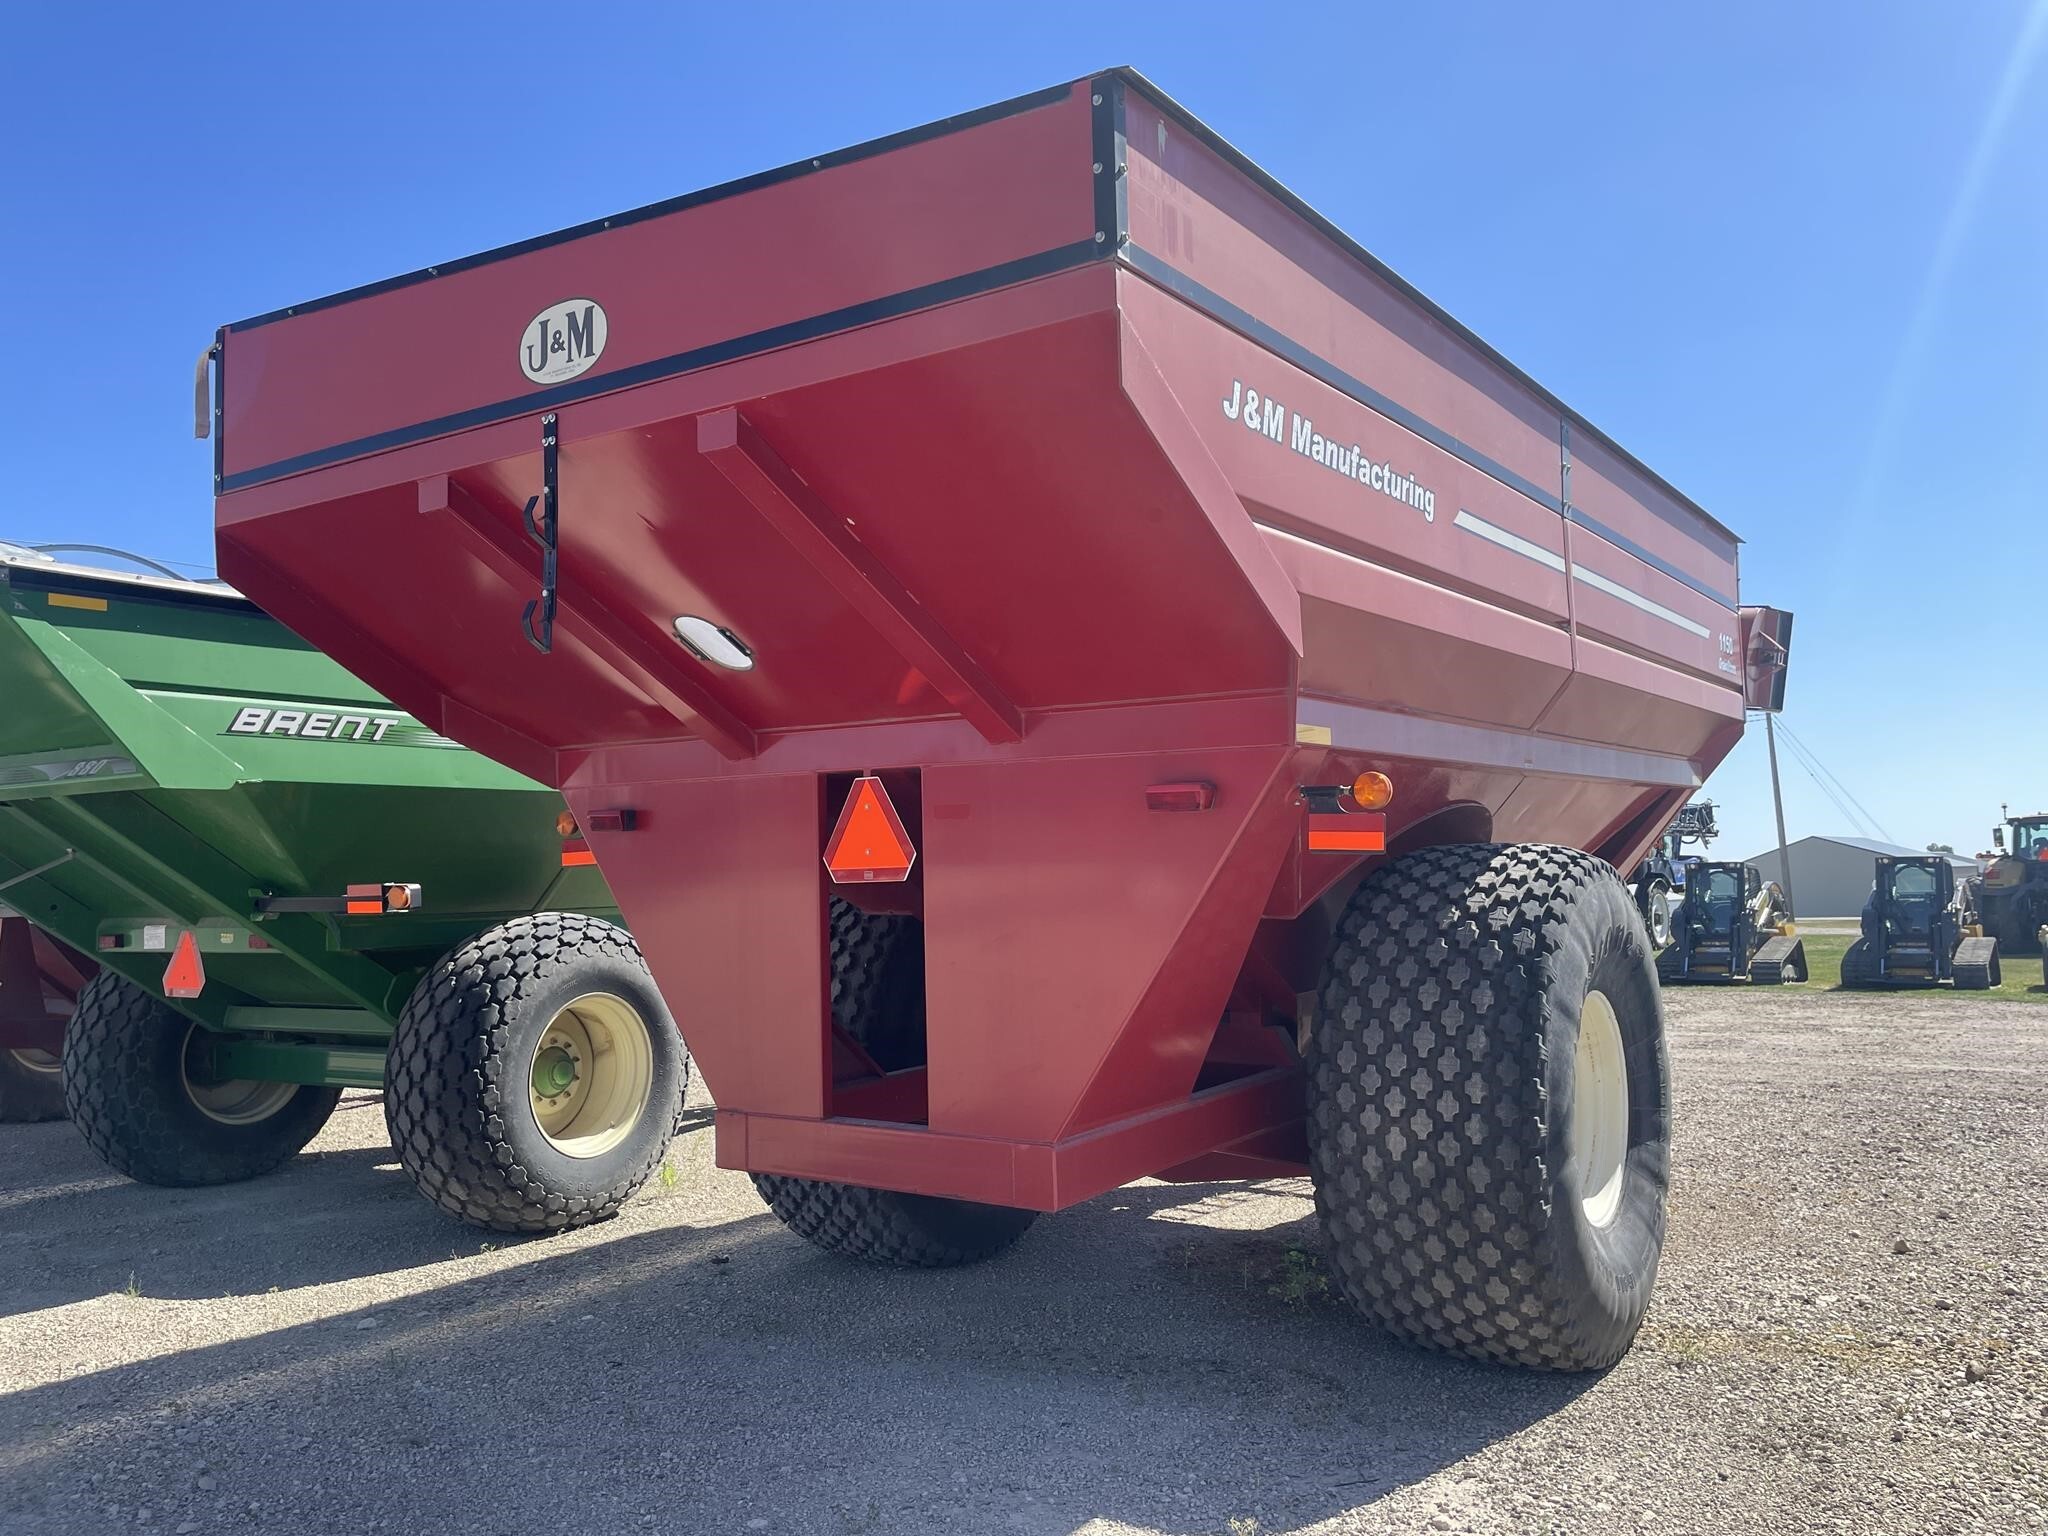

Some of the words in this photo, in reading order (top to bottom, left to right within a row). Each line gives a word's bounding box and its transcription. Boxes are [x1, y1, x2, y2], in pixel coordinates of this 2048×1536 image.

[526, 305, 596, 373] J&M
[1289, 411, 1436, 523] Manufacturing
[226, 706, 399, 743] BRENT
